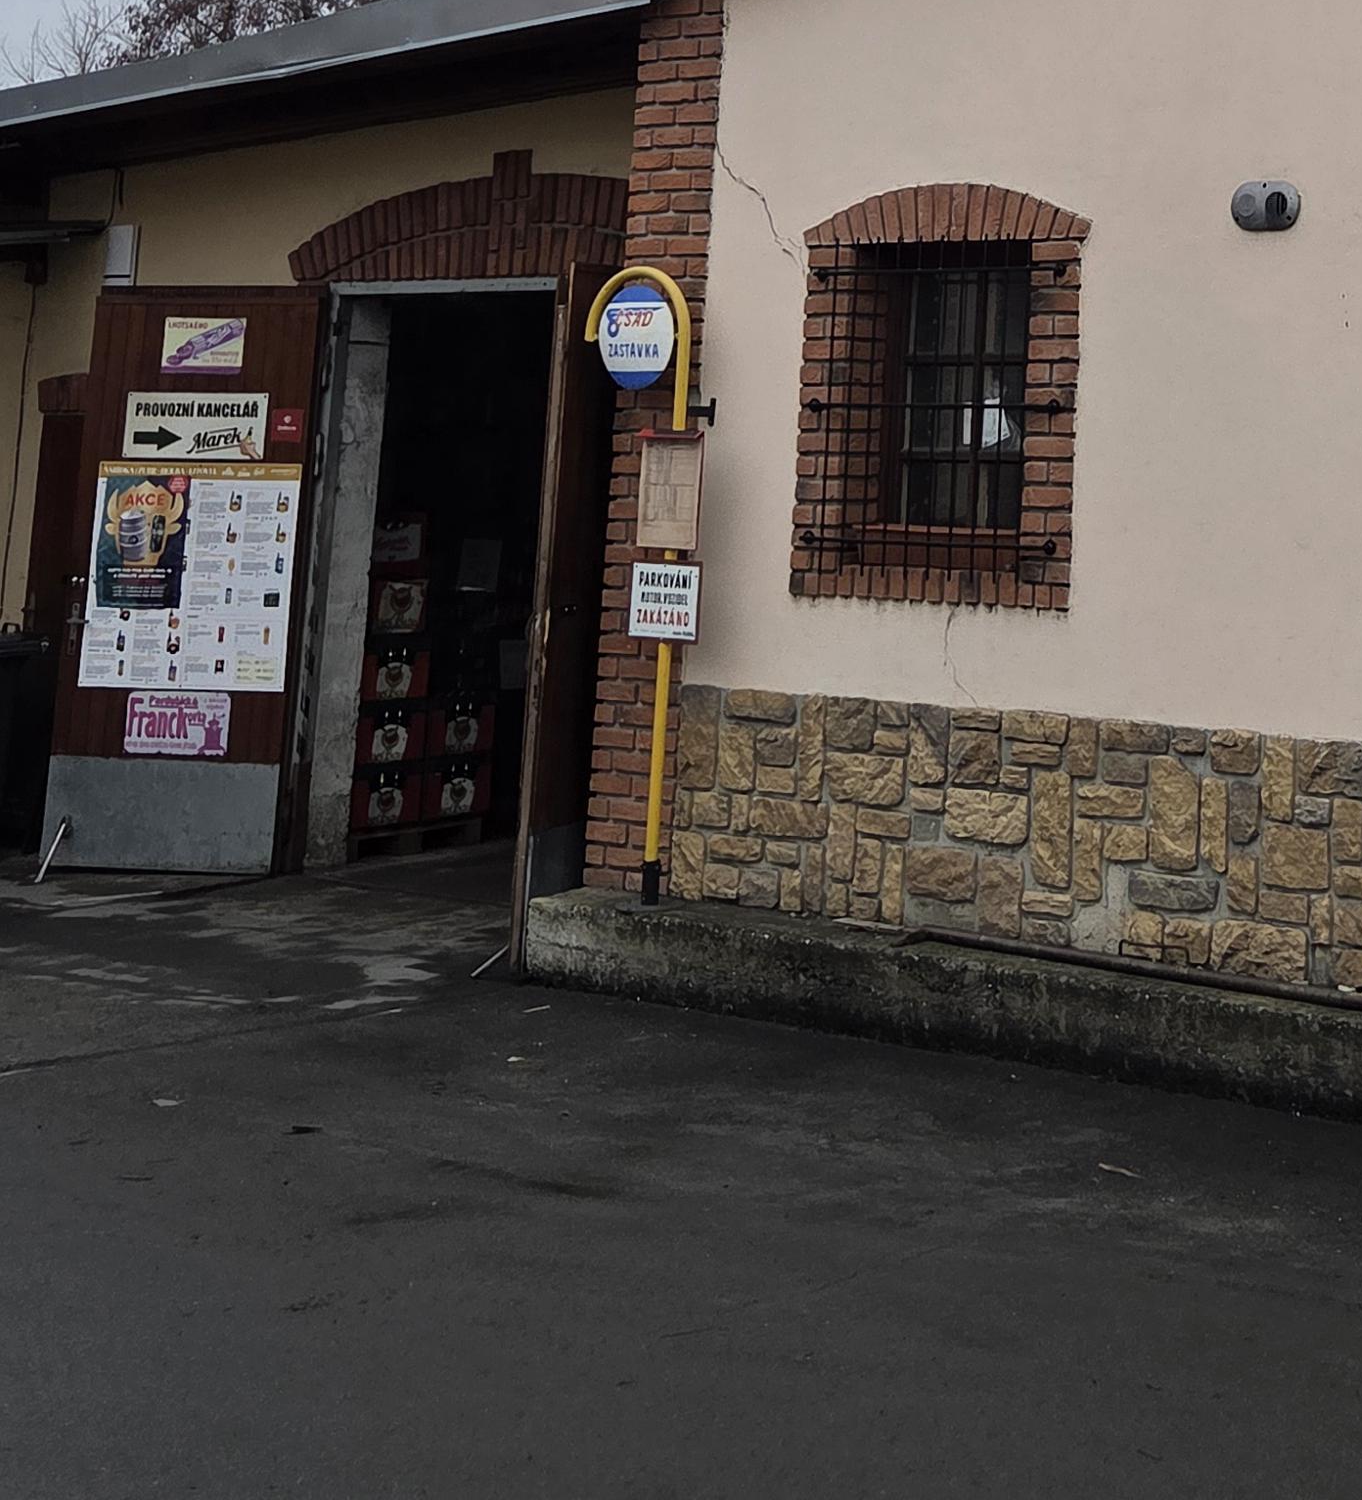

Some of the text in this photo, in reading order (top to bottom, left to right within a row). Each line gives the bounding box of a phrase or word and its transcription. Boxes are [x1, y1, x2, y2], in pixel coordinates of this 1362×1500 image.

[135, 400, 260, 418] PROVOZNÍ KANCELÁŘ
[186, 428, 242, 454] Marek
[124, 492, 167, 507] AKCE
[638, 569, 693, 590] PARKOVÁNÍ
[636, 606, 690, 627] ZAKÁZÁNO
